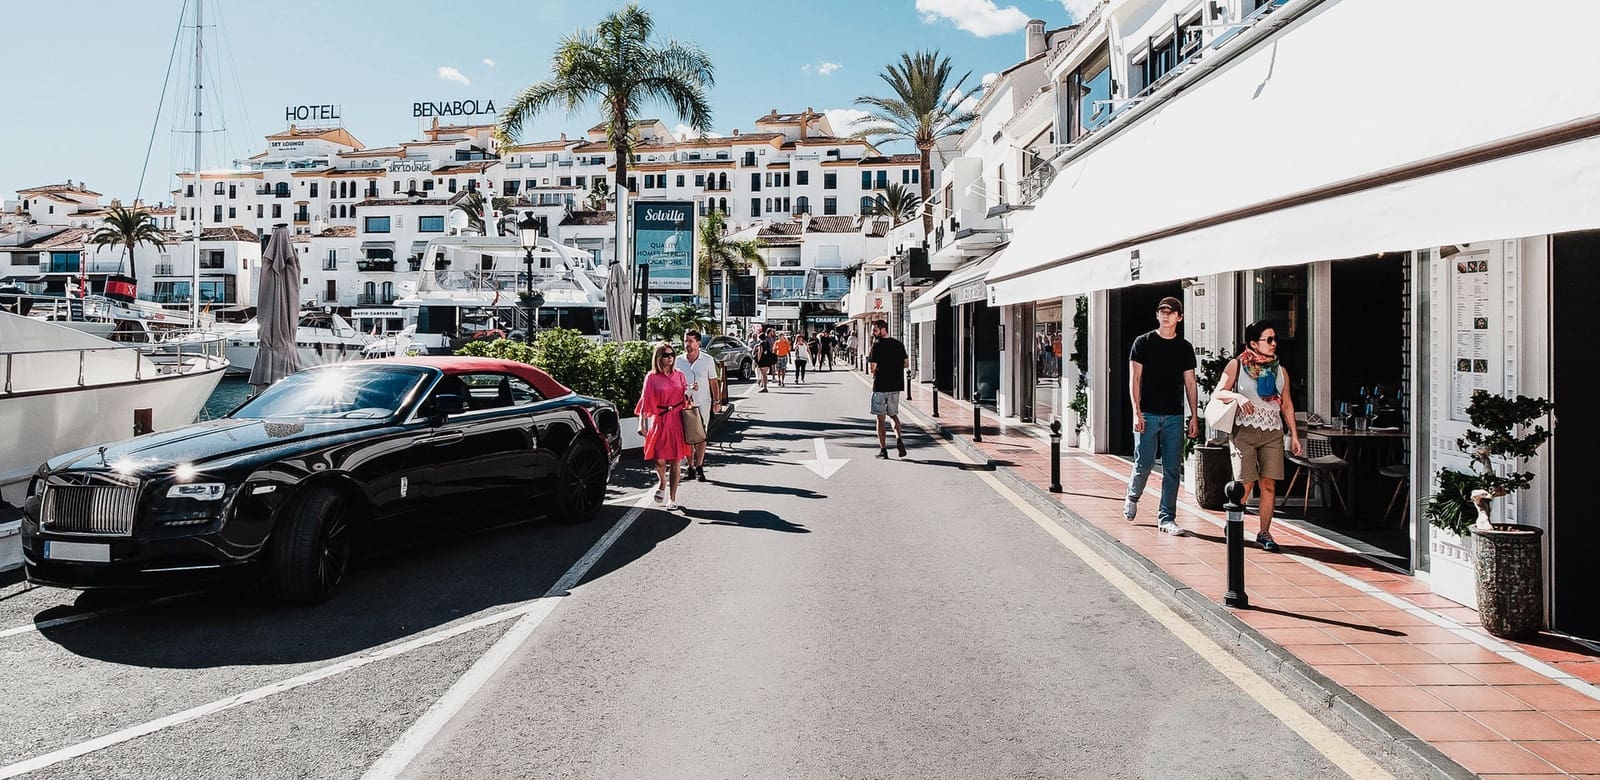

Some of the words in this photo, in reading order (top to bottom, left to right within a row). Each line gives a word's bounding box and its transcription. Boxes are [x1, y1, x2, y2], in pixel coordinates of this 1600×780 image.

[286, 104, 340, 120] HOTEL
[413, 99, 496, 117] BENABOLA
[388, 165, 401, 173] SKY
[402, 164, 431, 172] LOUNGE
[645, 208, 684, 221] Solvilla
[127, 285, 135, 295] X
